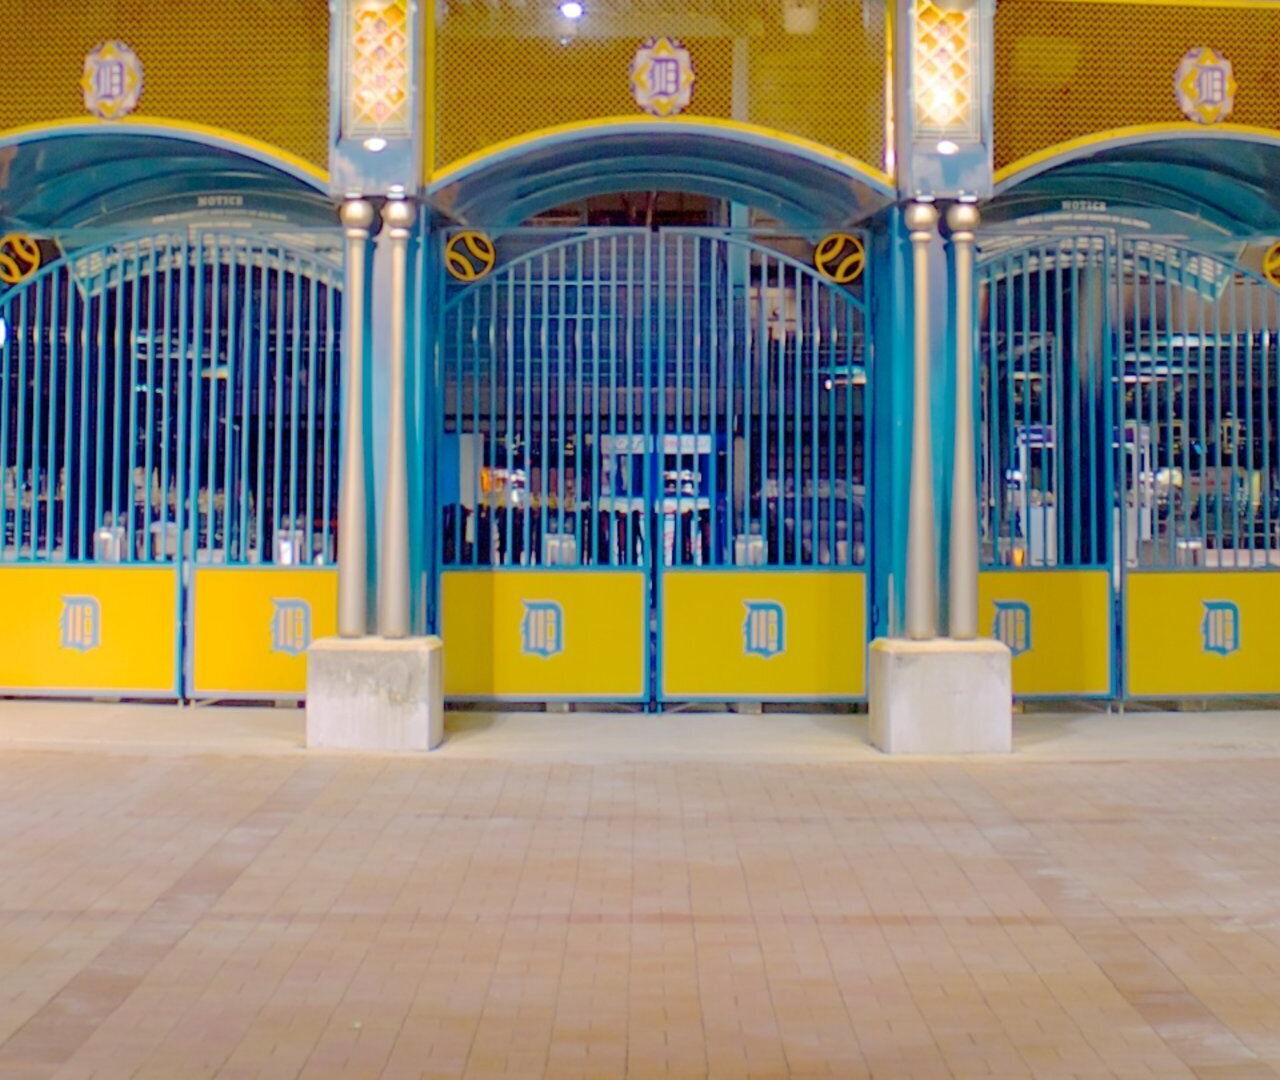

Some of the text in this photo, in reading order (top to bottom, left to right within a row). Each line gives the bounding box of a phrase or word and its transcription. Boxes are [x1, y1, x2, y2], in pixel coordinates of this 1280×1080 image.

[197, 195, 244, 207] NOTICE
[1061, 200, 1107, 212] NOTICE
[62, 595, 99, 651] D
[523, 600, 562, 657] D
[744, 600, 784, 657] D
[1203, 600, 1237, 655] D
